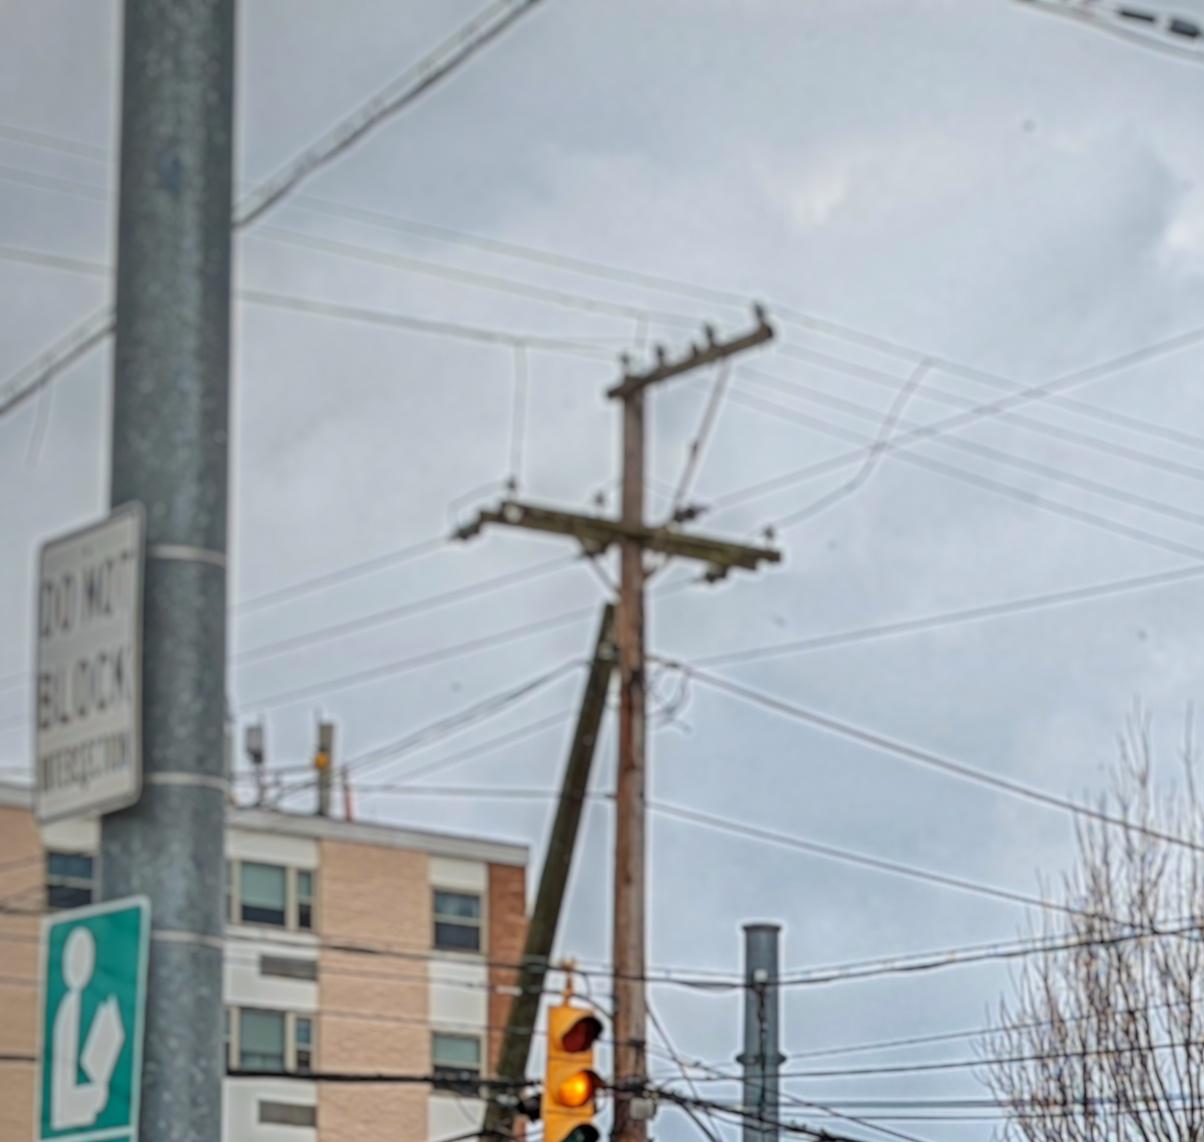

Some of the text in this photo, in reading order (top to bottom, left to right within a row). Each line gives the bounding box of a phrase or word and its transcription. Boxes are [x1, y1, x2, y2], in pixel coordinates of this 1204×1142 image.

[39, 550, 135, 637] DO NOT
[38, 649, 132, 731] BLOCK
